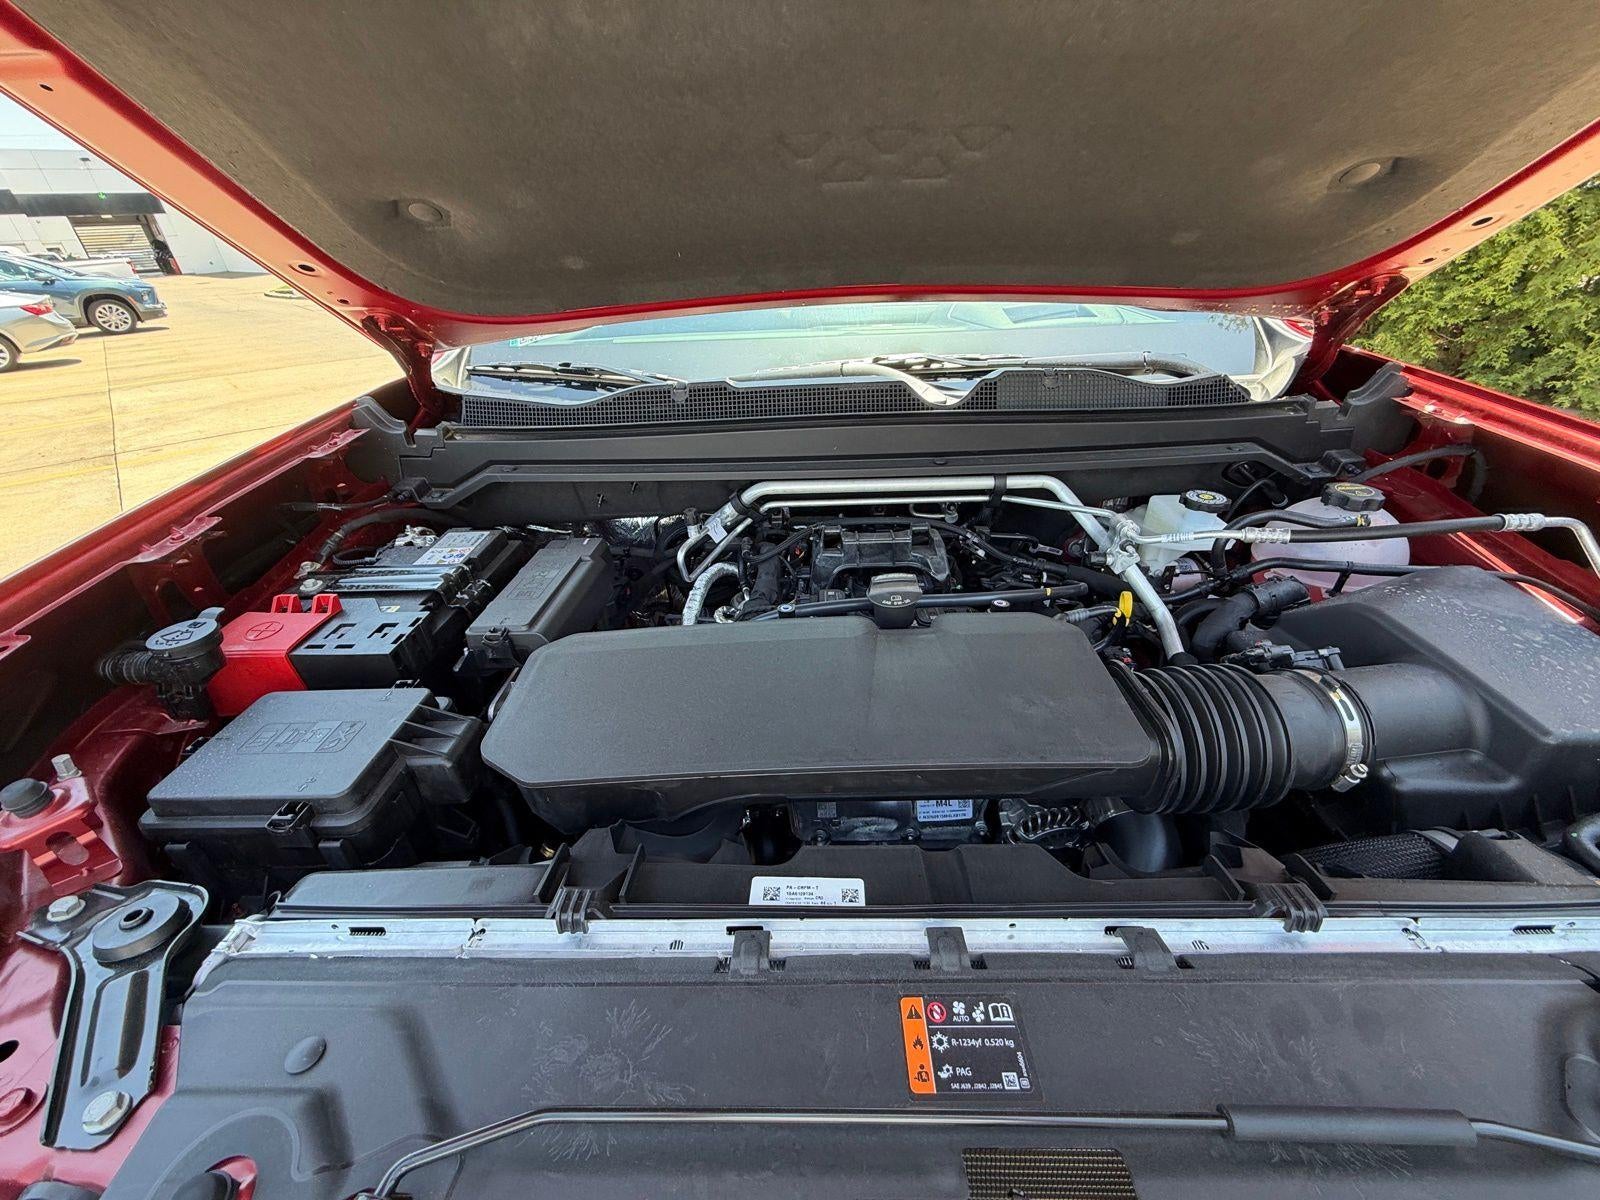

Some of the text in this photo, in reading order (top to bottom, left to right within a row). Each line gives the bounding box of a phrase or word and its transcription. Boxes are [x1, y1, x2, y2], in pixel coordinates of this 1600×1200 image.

[951, 1038, 1015, 1048] R-1234yf 0.520 kg
[955, 1066, 972, 1076] PAG
